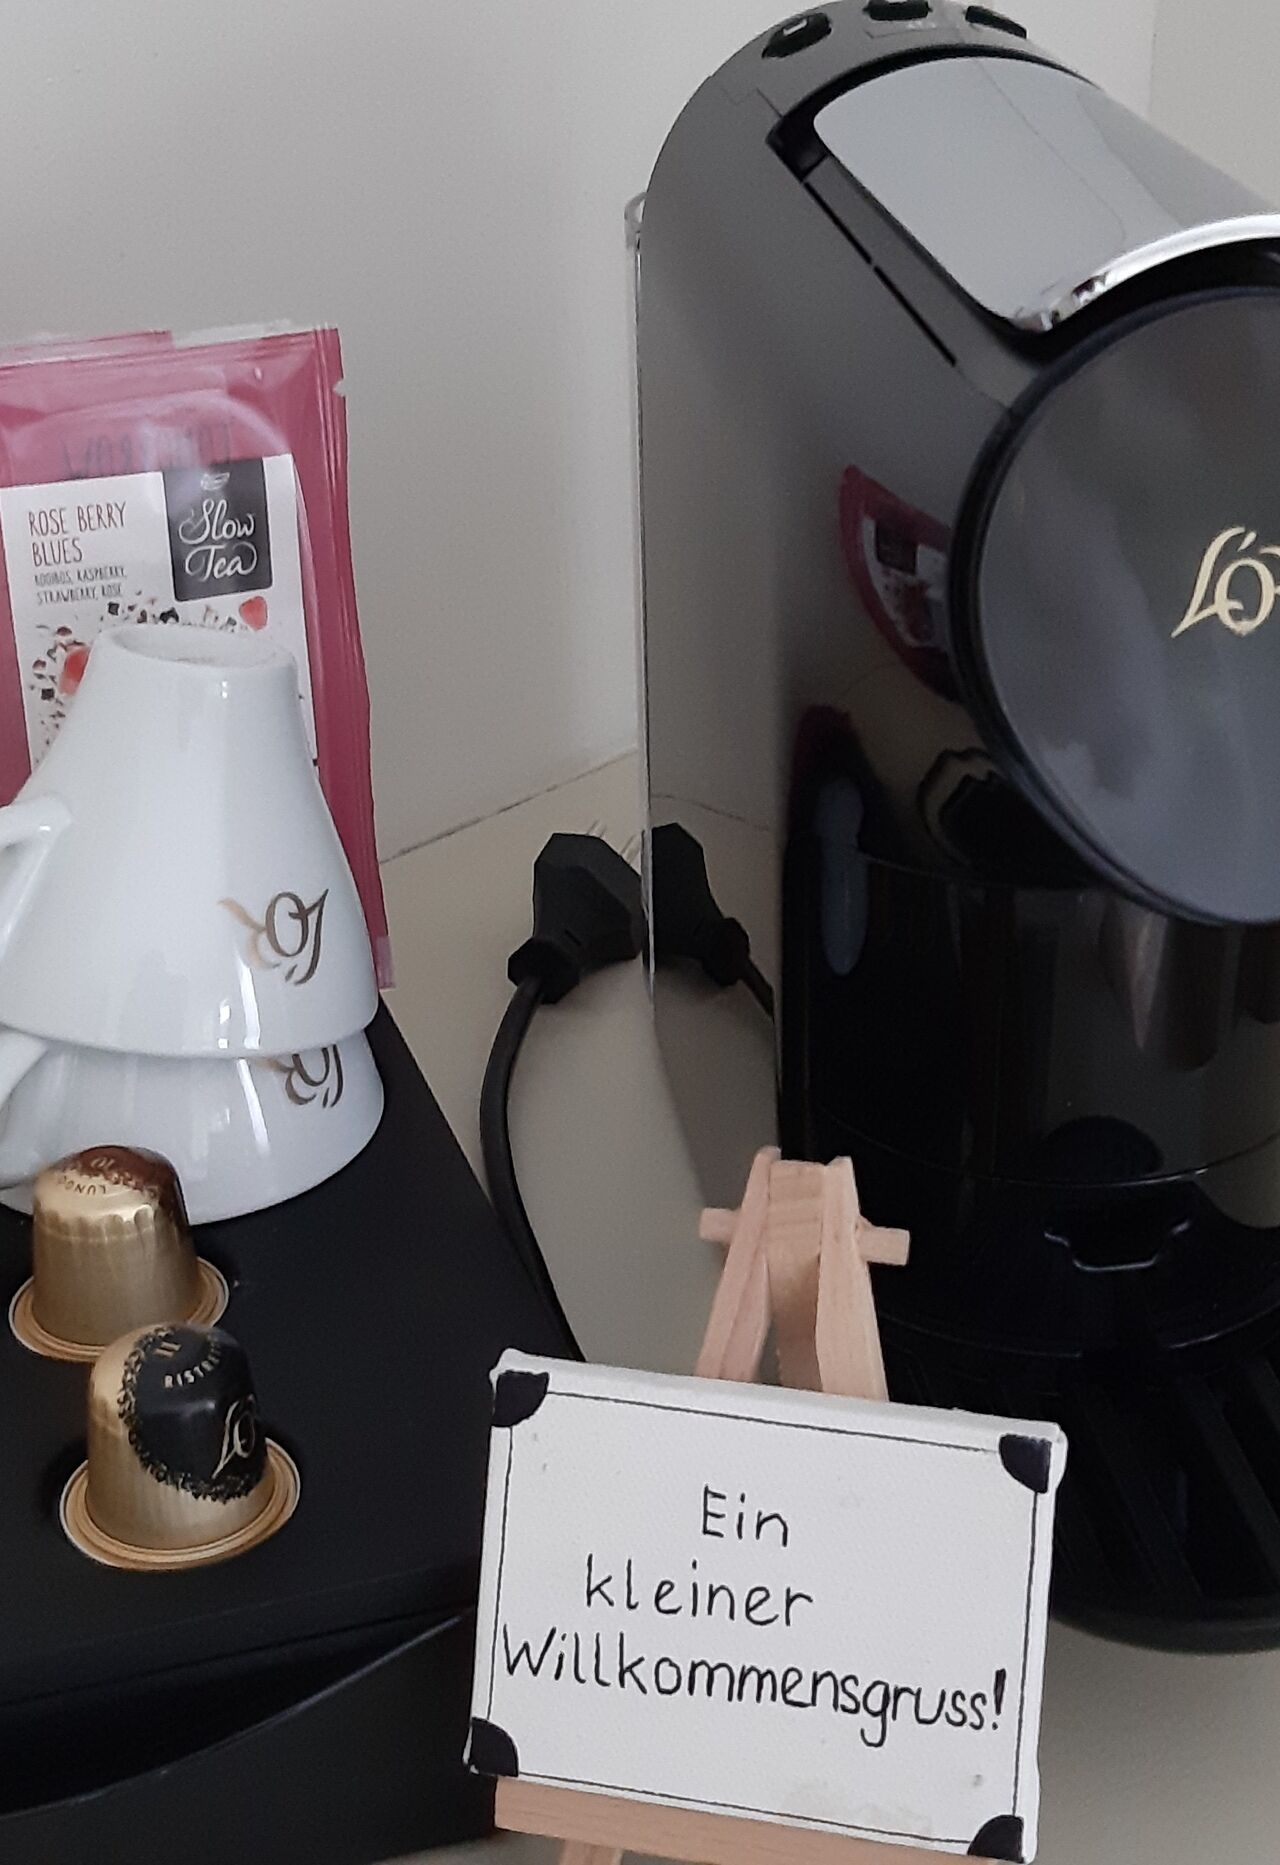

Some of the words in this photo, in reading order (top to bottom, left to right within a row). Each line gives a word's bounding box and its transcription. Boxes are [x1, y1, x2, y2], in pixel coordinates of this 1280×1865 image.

[28, 507, 68, 537] ROSE
[77, 501, 127, 533] BERRY
[178, 498, 254, 545] Slow
[32, 537, 83, 568] BLUES
[185, 541, 257, 582] Tea
[701, 1484, 789, 1547] Ein
[585, 1553, 814, 1627] kleiner
[502, 1623, 1008, 1748] Willkommensgruss!
